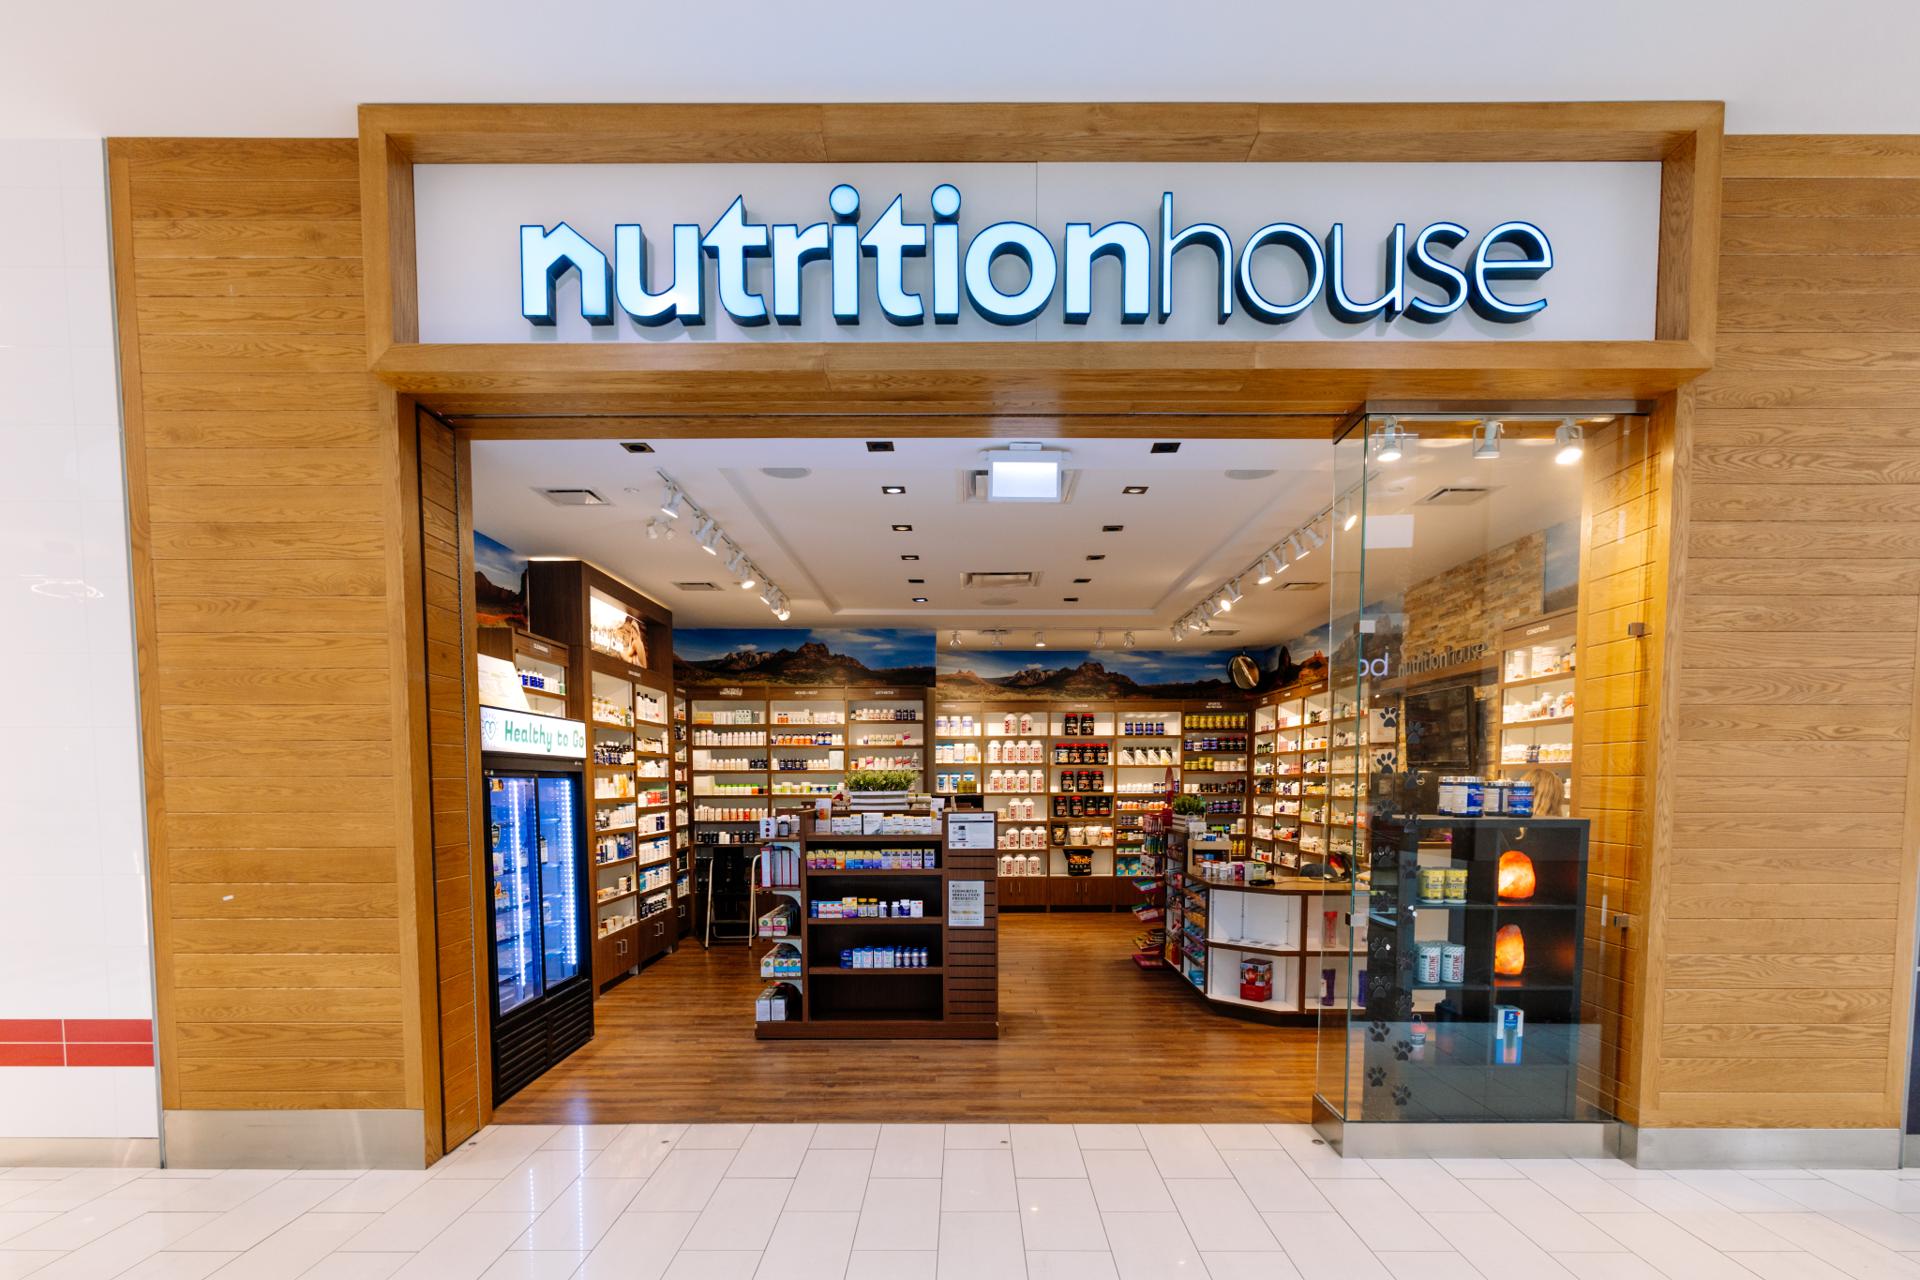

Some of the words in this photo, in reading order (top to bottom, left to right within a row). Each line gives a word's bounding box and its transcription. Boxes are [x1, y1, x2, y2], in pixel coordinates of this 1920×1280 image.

[519, 183, 1553, 325] nutritionhouse
[505, 720, 553, 752] Healthy
[557, 730, 569, 747] to
[573, 729, 585, 749] Go
[1428, 955, 1437, 982] CREATINE
